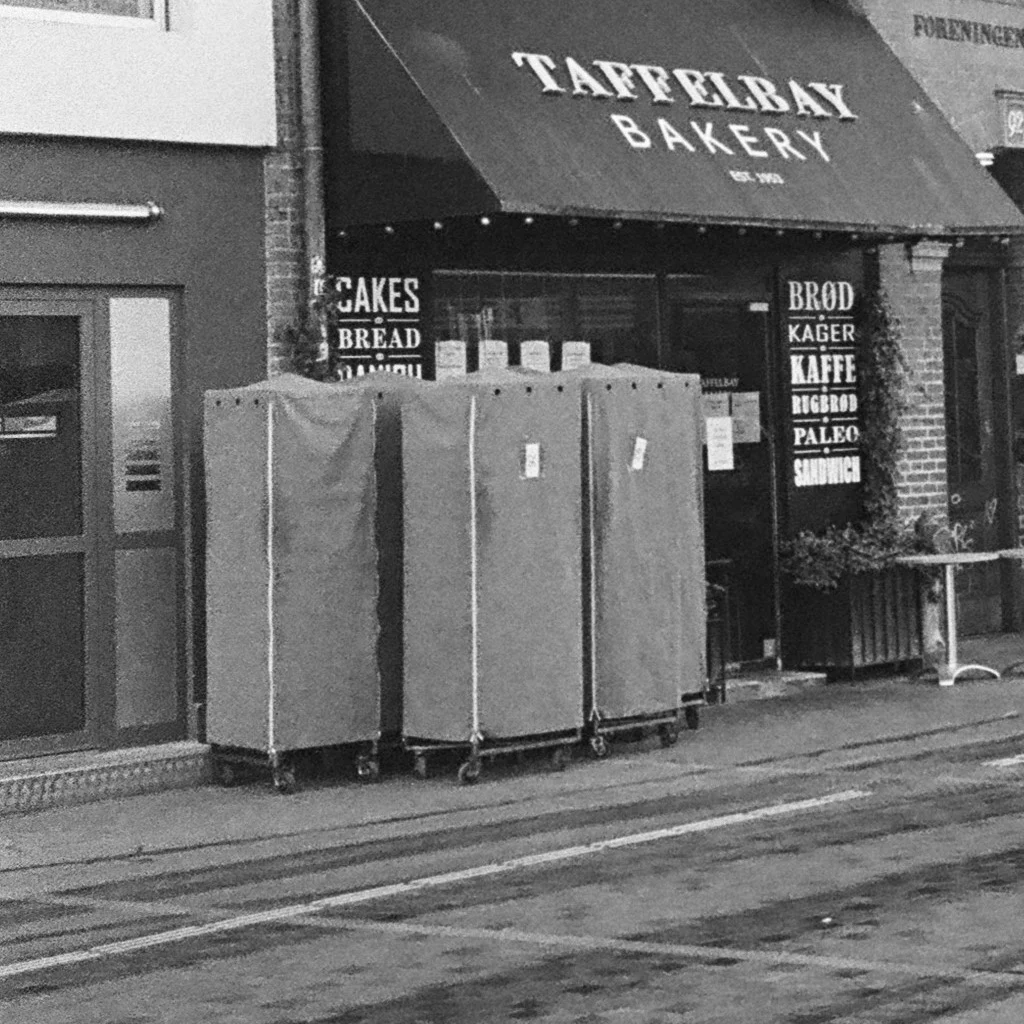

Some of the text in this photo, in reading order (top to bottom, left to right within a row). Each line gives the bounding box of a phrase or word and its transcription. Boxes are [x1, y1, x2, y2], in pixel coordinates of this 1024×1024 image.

[510, 51, 859, 120] TAFFELBAY
[610, 113, 831, 162] BAKERY
[335, 275, 421, 314] CAKES
[788, 280, 855, 312] BRØD
[338, 327, 422, 350] BREAD
[788, 323, 856, 344] KAGER
[790, 354, 857, 385] KAFFE
[791, 393, 859, 416] RUGBRØD
[793, 425, 860, 447] PALEO
[793, 455, 861, 488] SANDWICH
